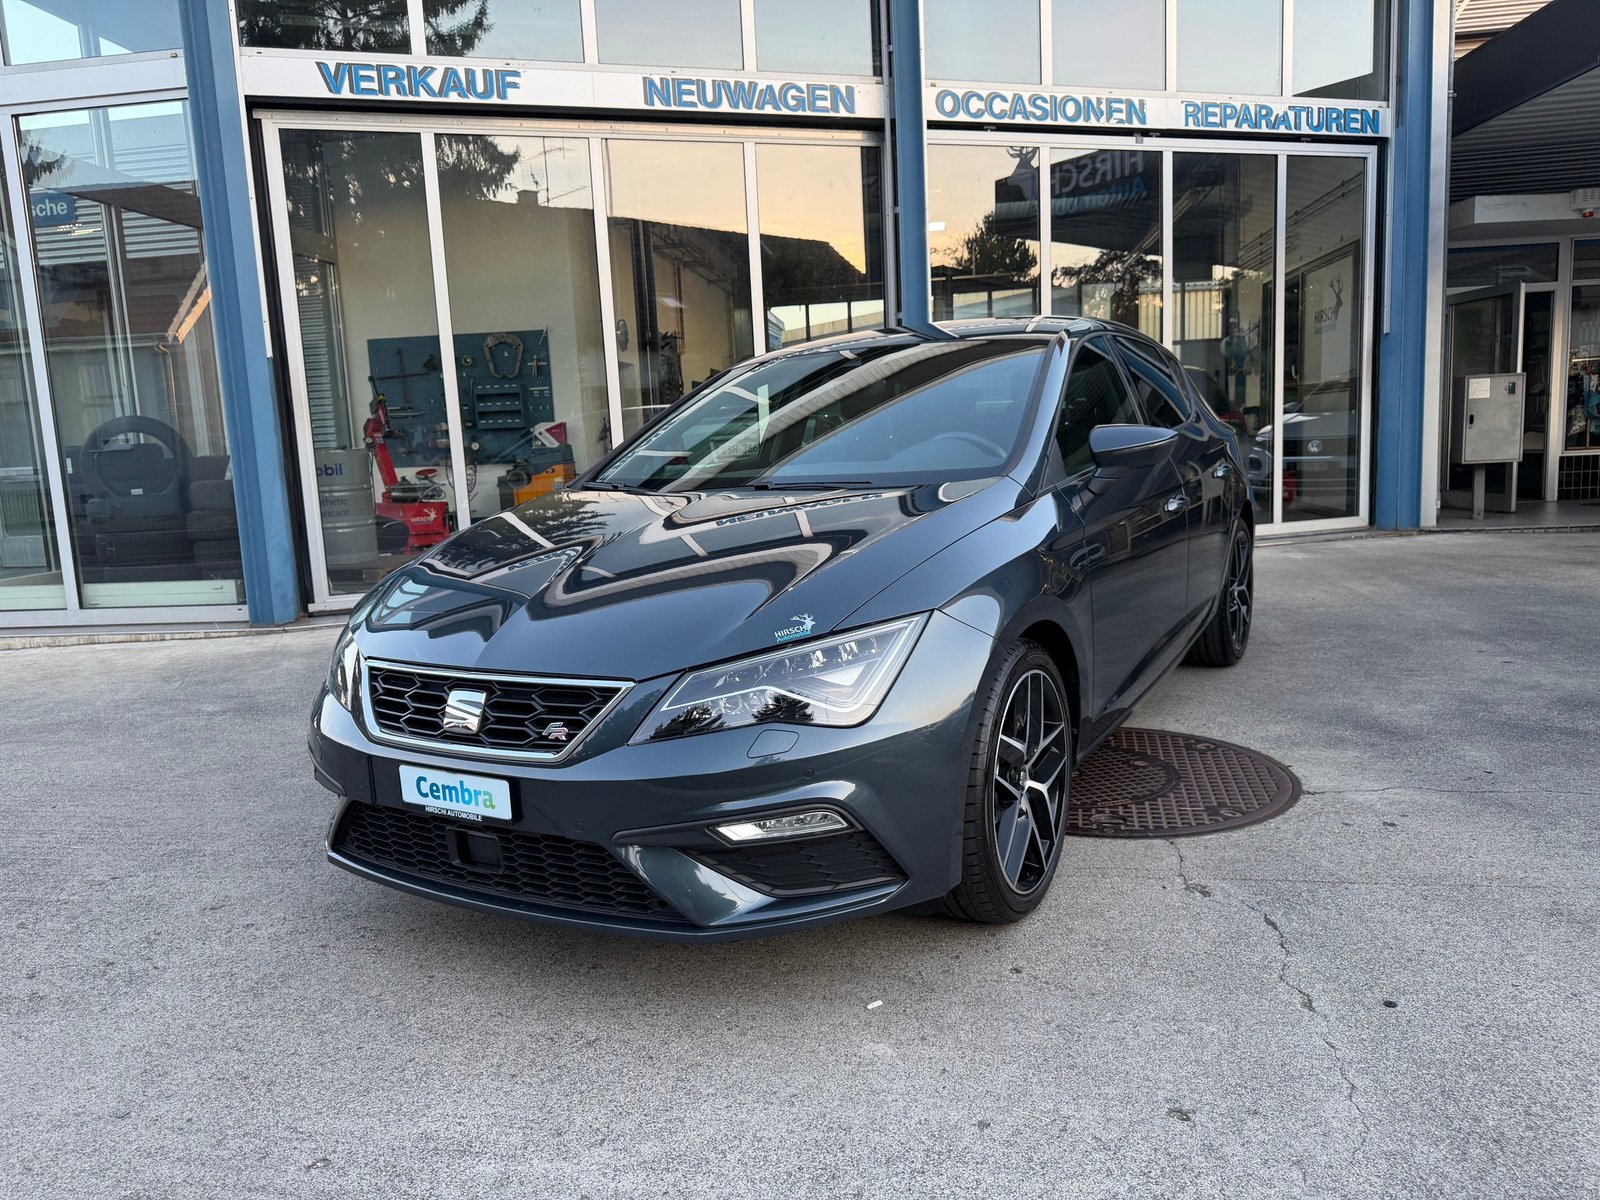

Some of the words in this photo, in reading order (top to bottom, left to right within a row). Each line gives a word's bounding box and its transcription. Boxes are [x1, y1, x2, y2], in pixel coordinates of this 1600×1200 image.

[315, 61, 521, 101] VERKAUF
[642, 76, 856, 115] NEUWAGEN
[935, 89, 1148, 125] OCCASIONEN
[1181, 100, 1380, 135] REPARATUREN
[31, 198, 68, 217] sche
[316, 463, 343, 477] obil
[321, 496, 349, 507] thetic
[776, 630, 812, 643] Automobile
[542, 721, 569, 741] FR
[415, 775, 496, 810] Cembra
[425, 805, 447, 815] HIRSCHI
[447, 810, 483, 822] AUTOMOBILE
